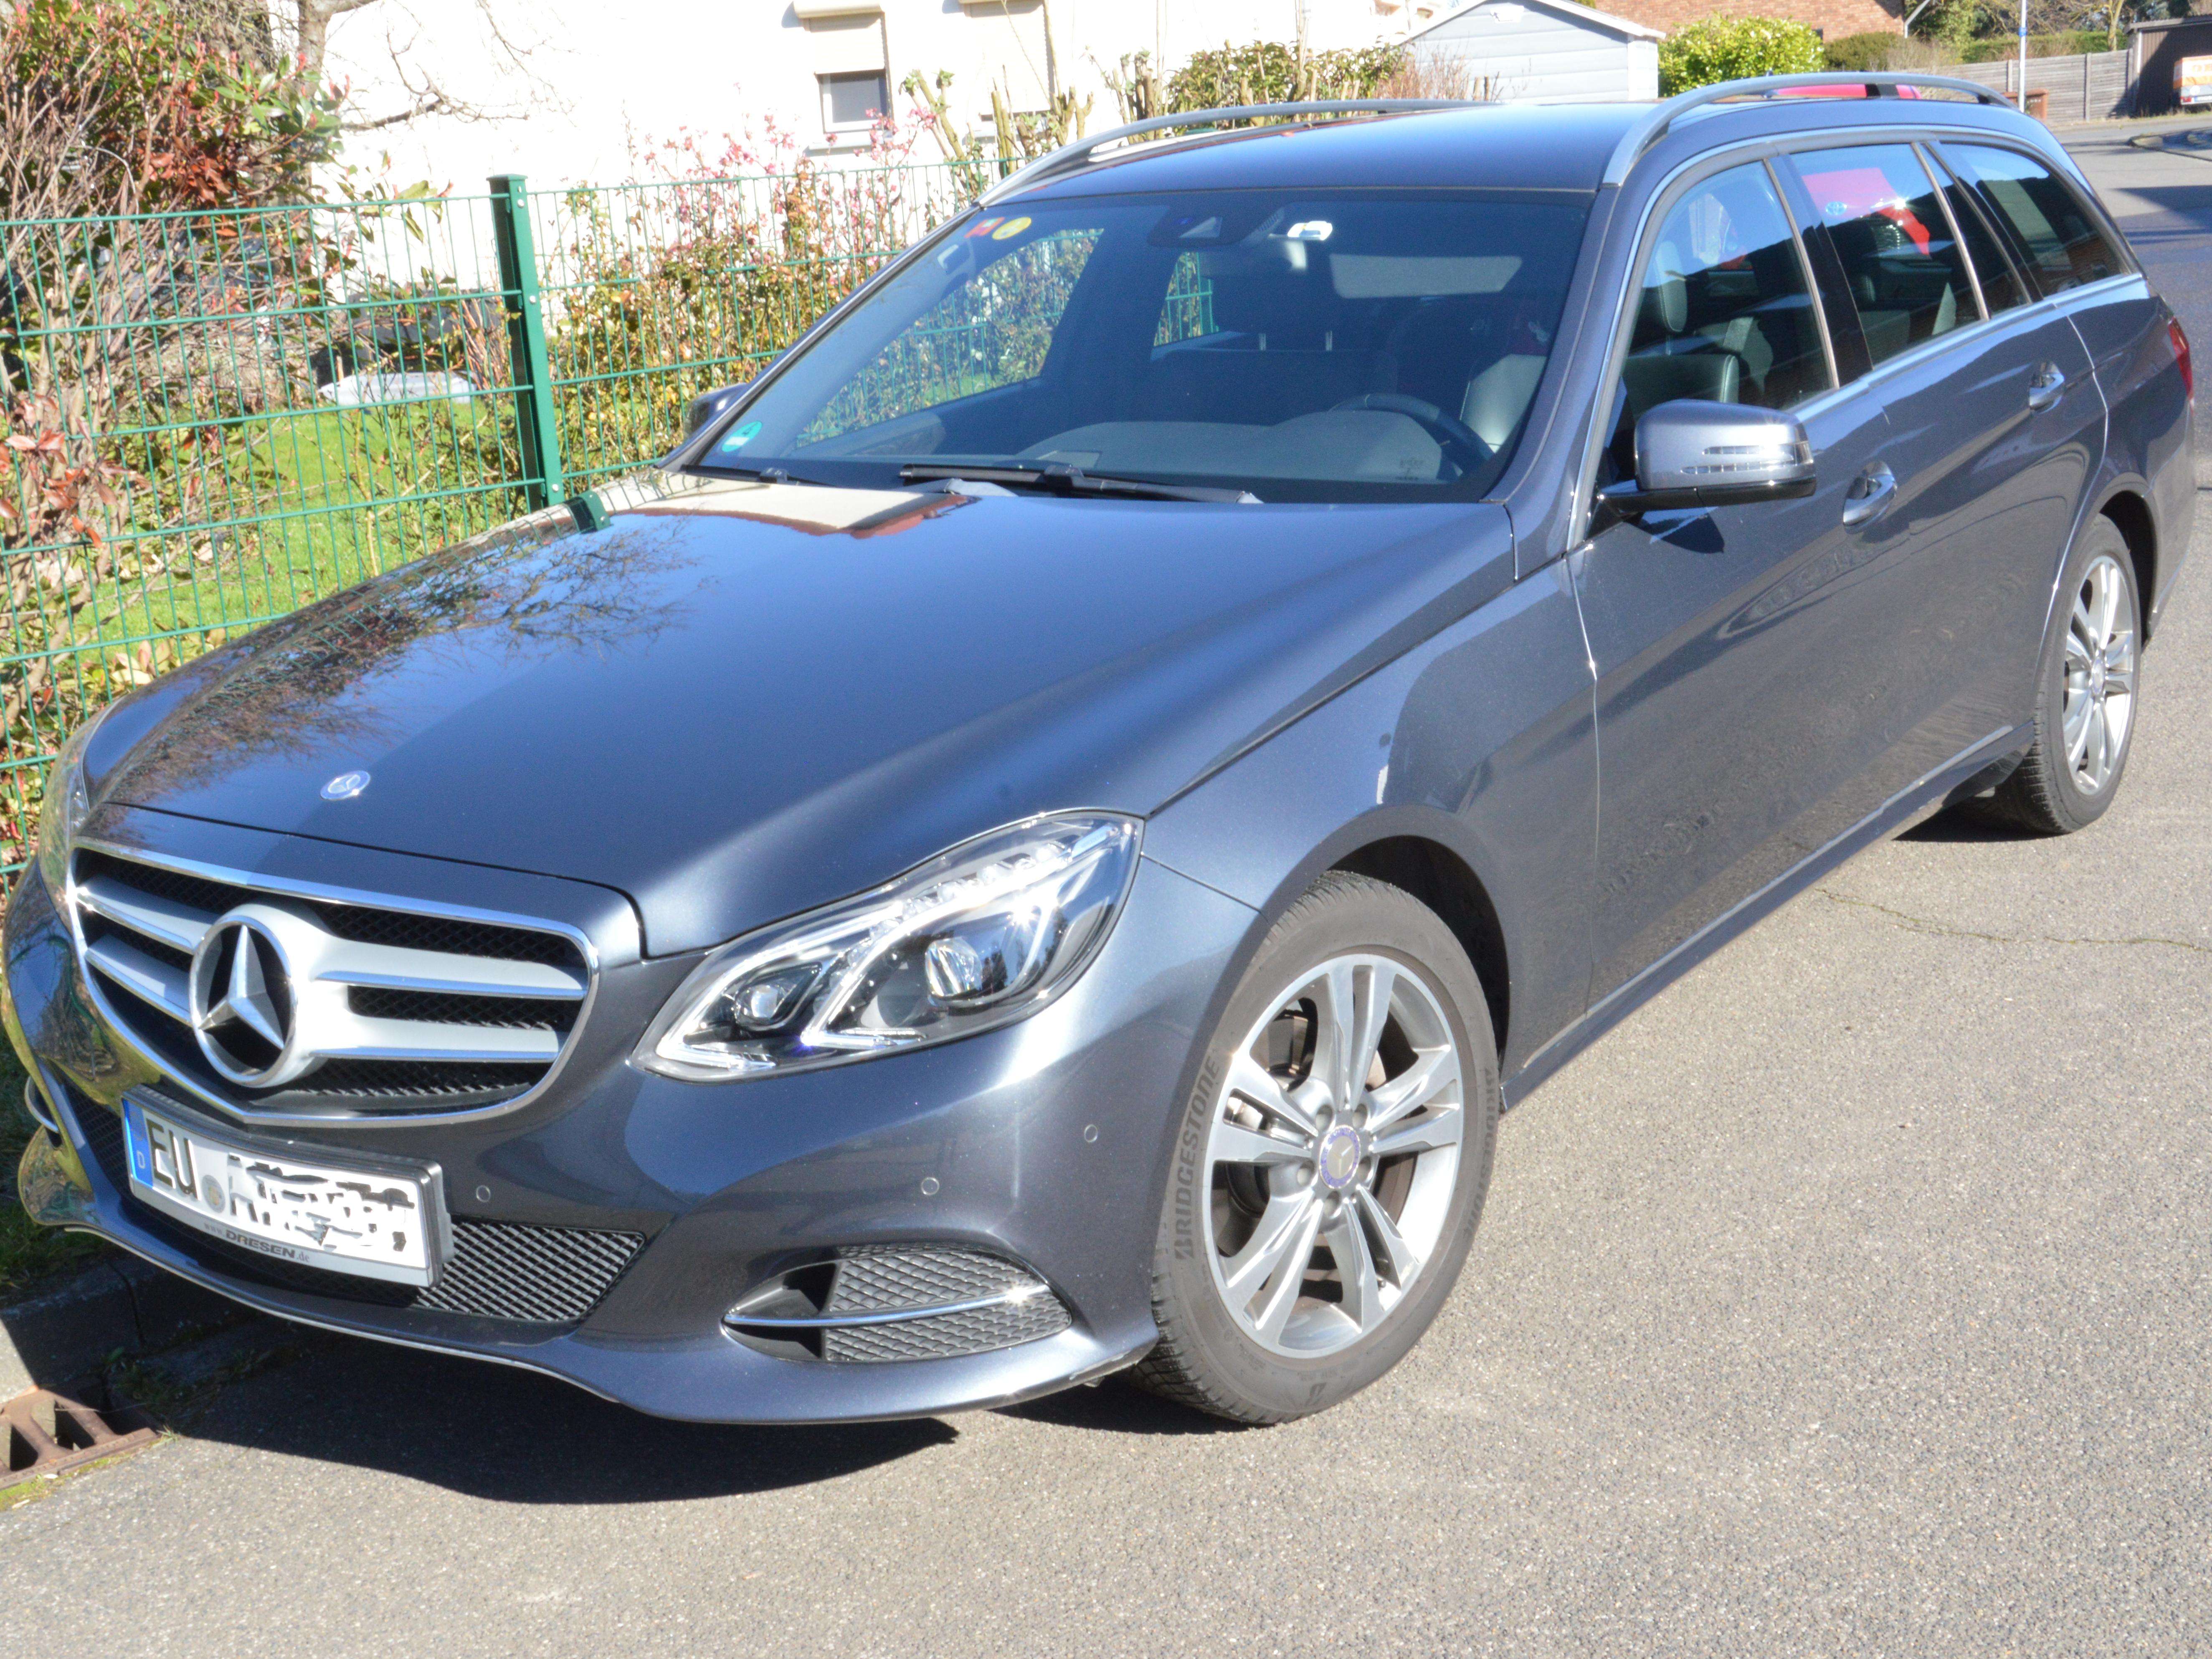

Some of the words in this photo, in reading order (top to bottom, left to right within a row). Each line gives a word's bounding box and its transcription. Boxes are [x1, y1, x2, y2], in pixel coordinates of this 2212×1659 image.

[136, 1149, 145, 1169] D
[147, 1118, 200, 1200] EU
[1174, 1056, 1219, 1260] BRIDGESTONE
